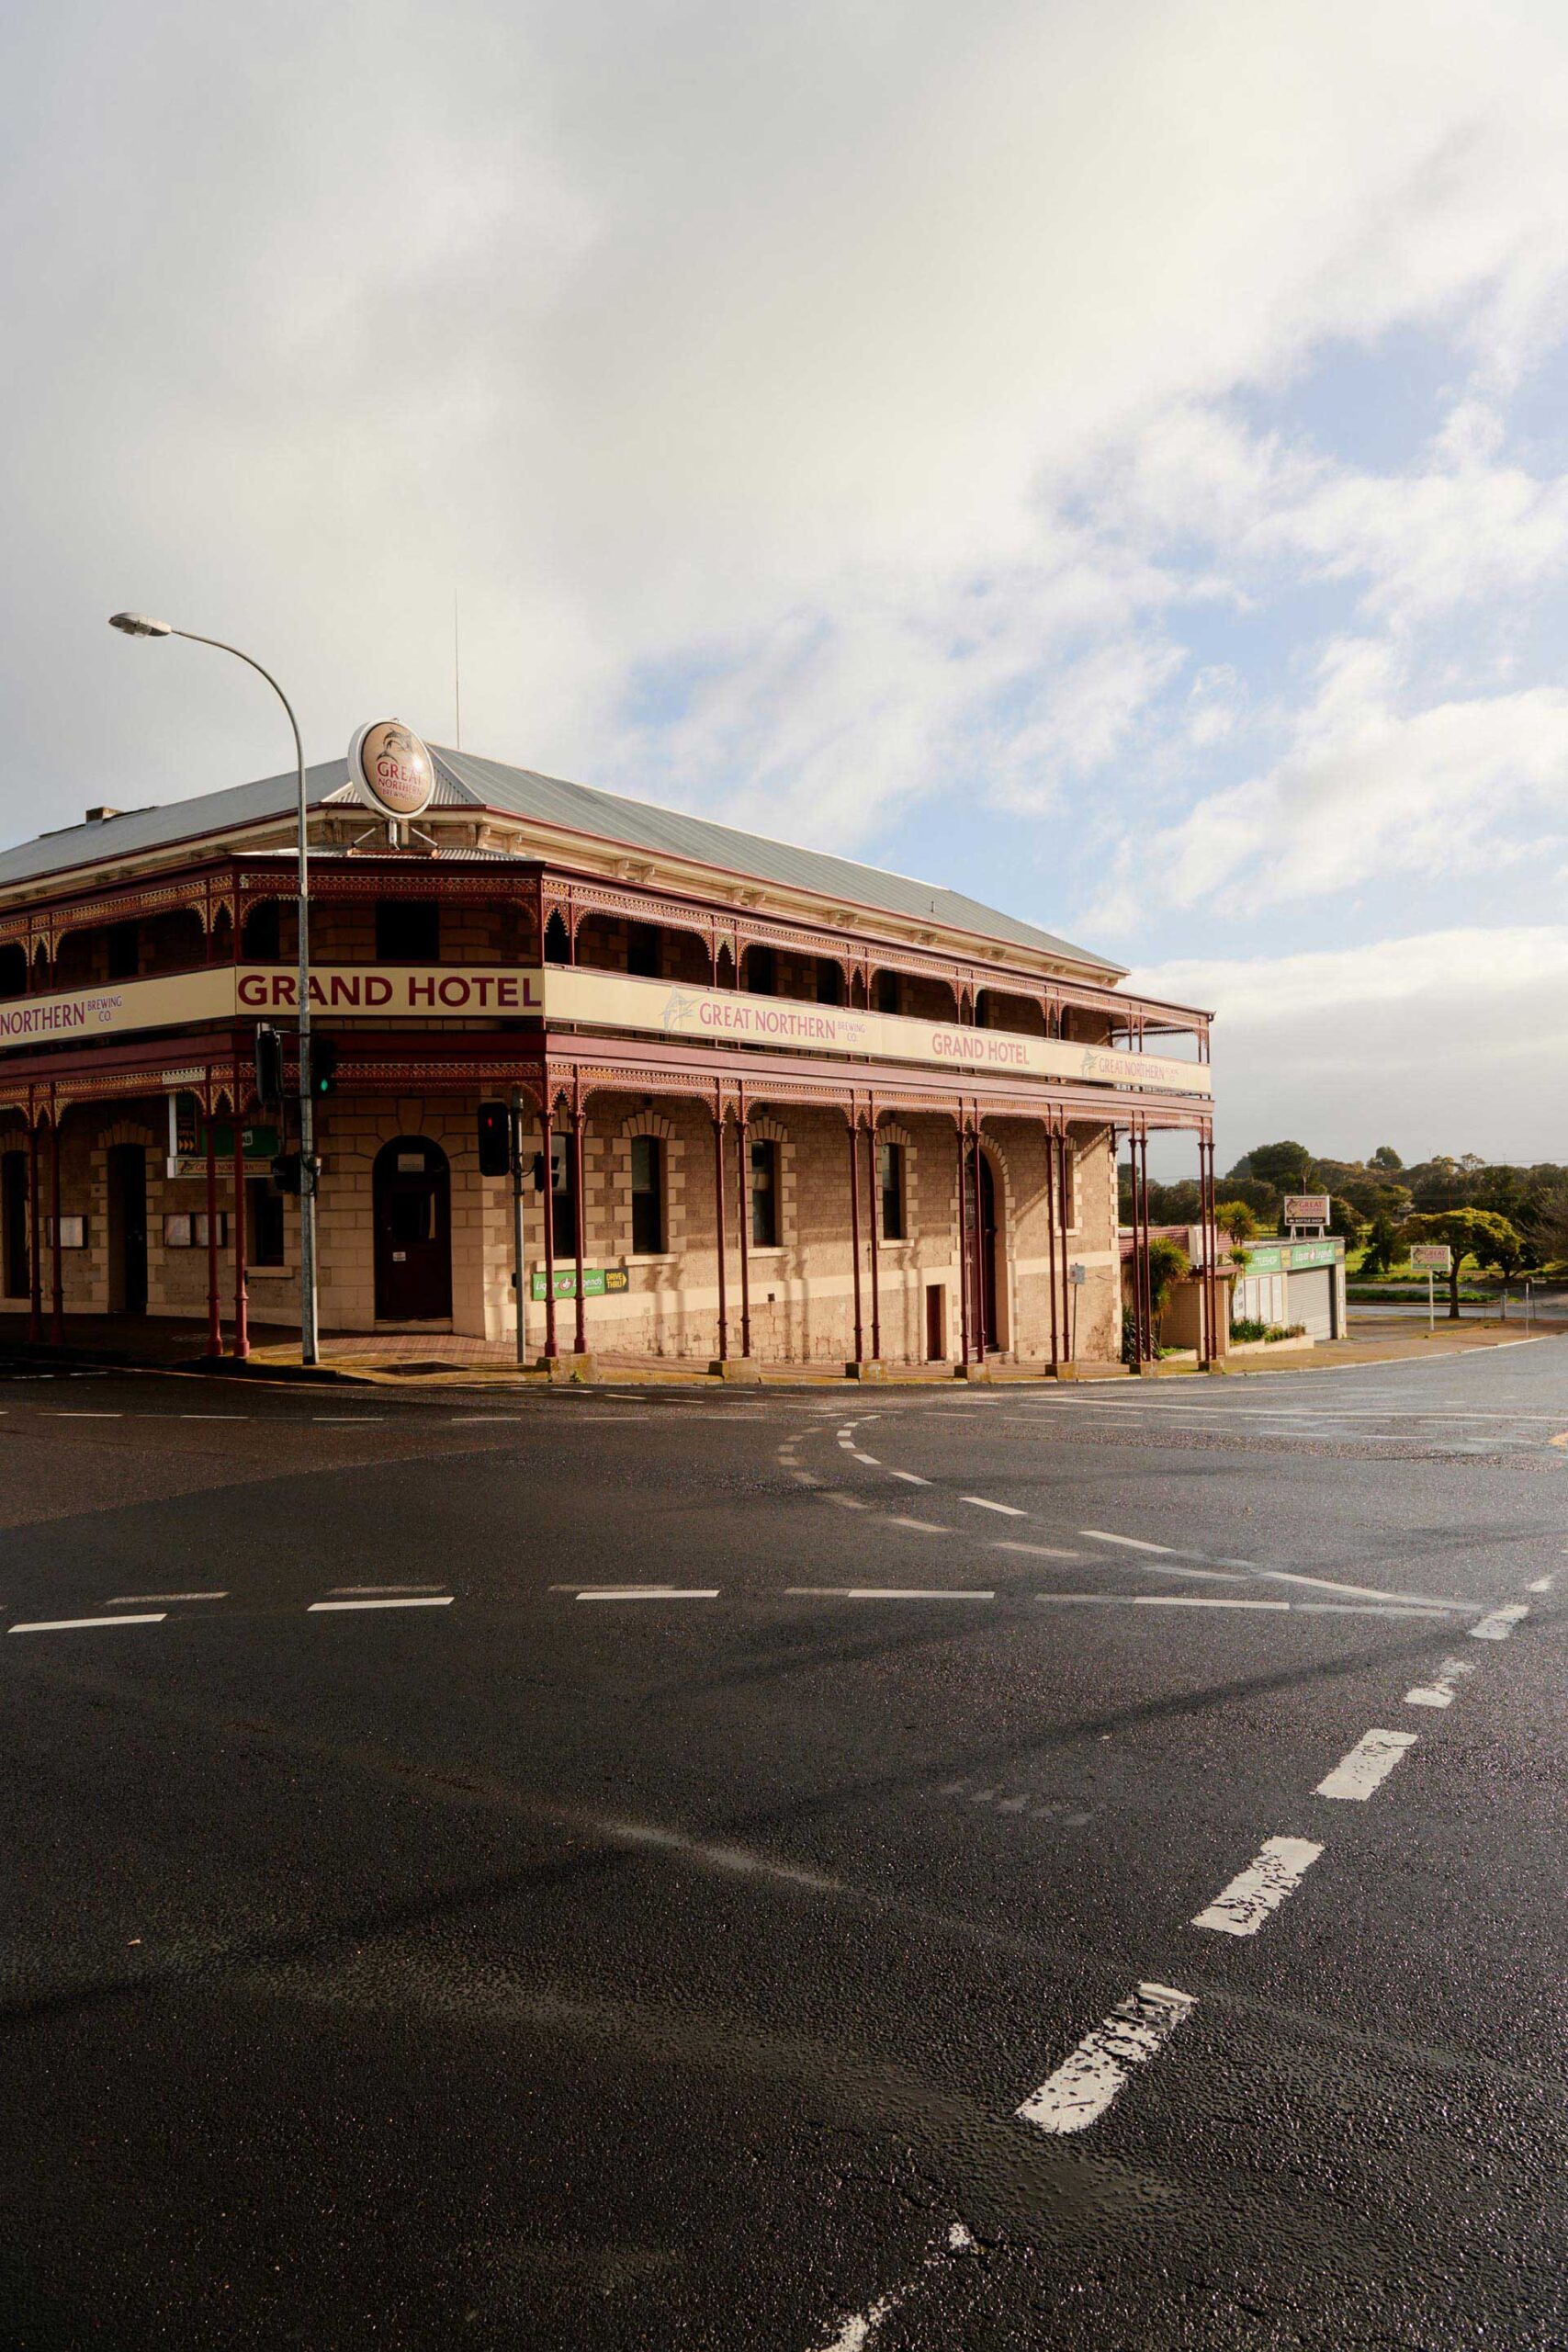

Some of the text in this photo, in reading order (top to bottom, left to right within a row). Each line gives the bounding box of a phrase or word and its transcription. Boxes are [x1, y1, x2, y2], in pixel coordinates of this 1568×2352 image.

[377, 761, 423, 786] GREAT
[87, 995, 122, 1011] BREWING
[237, 974, 542, 1008] GRAND HOTEL
[0, 1001, 85, 1035] NORTHERN
[699, 1002, 836, 1040] GREAT NORTHERN
[838, 1021, 867, 1034] BREWING
[932, 1033, 1030, 1065] GRAND HOTEL
[1099, 1057, 1123, 1074] GREAT
[1124, 1060, 1165, 1080] NORTHERN
[606, 1272, 624, 1281] DRIVE
[607, 1281, 624, 1289] THRU
